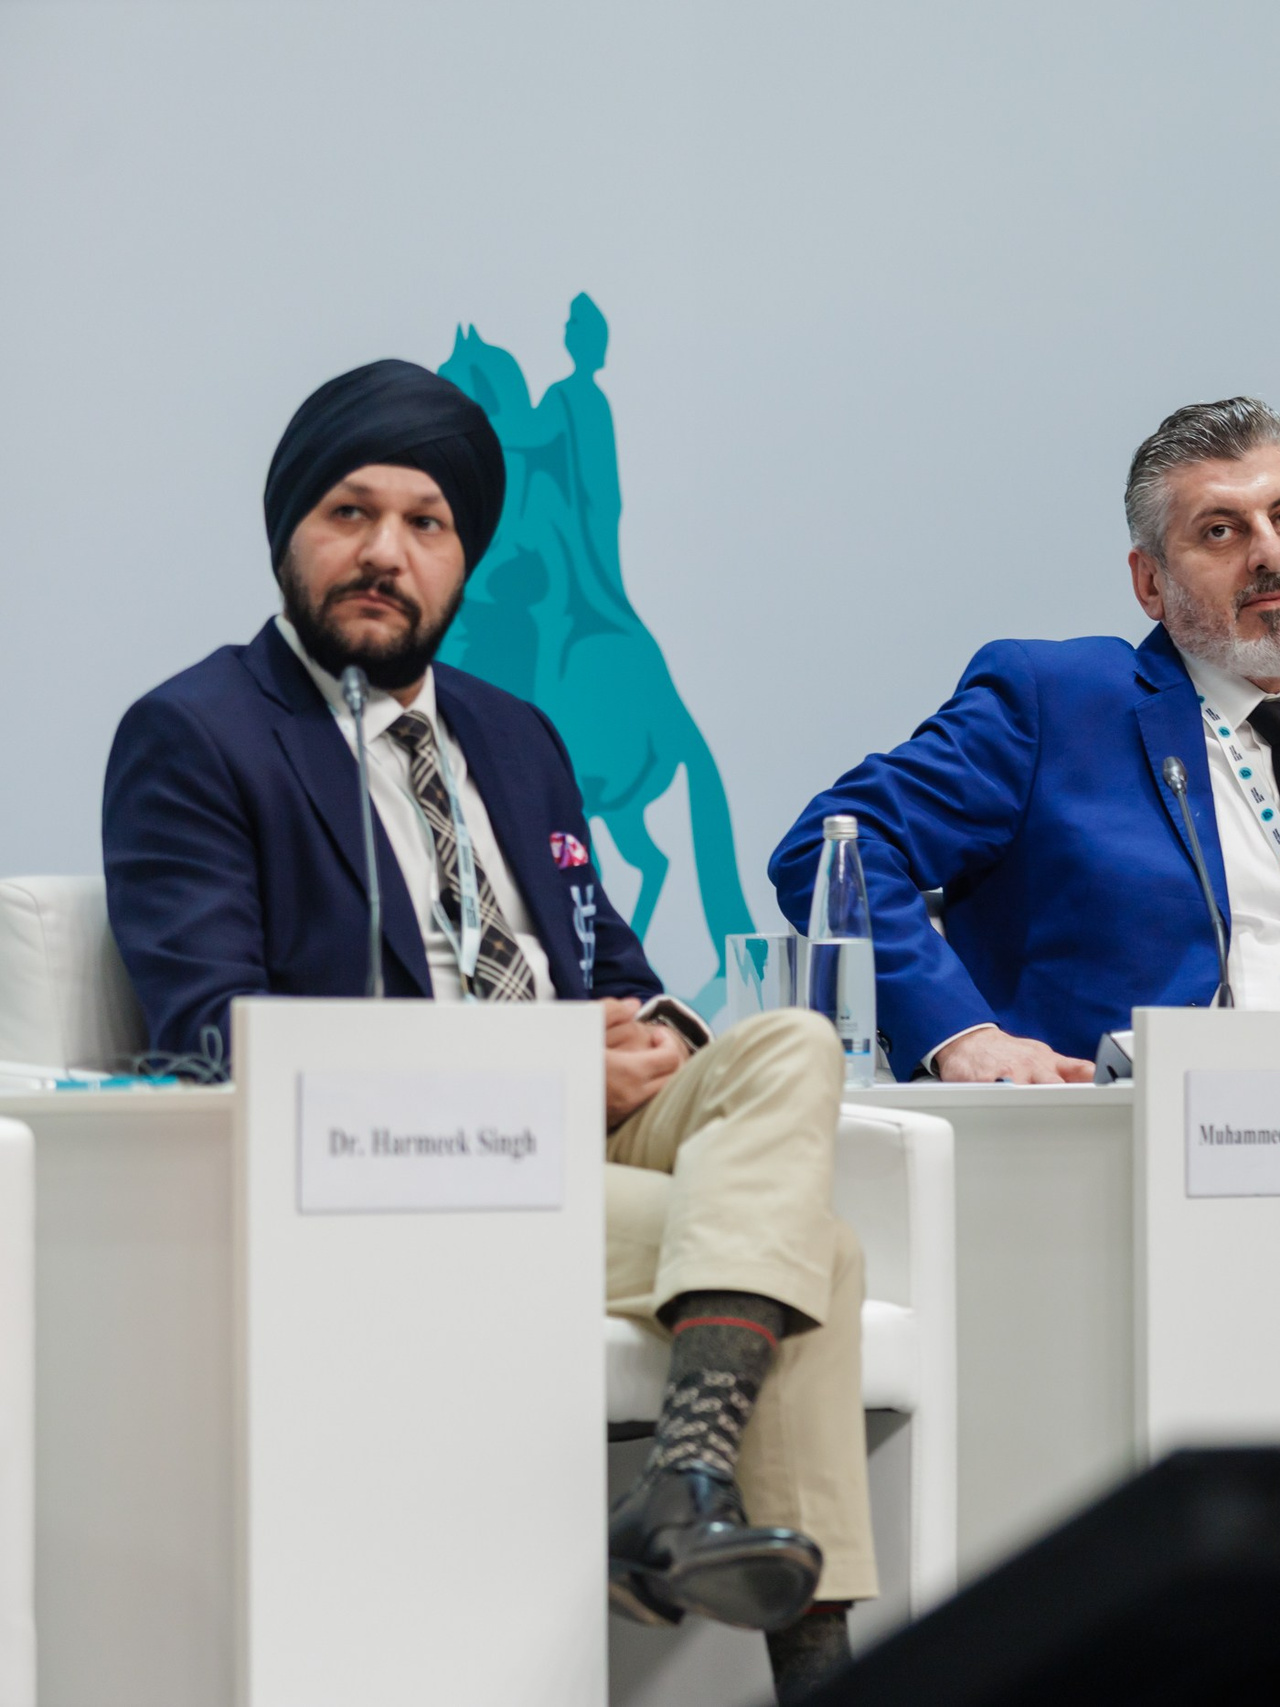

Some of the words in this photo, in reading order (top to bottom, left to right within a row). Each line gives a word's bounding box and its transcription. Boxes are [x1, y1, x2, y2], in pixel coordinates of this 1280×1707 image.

[329, 1128, 365, 1156] Dr.
[372, 1128, 470, 1156] Harmeek
[477, 1129, 536, 1161] Singh
